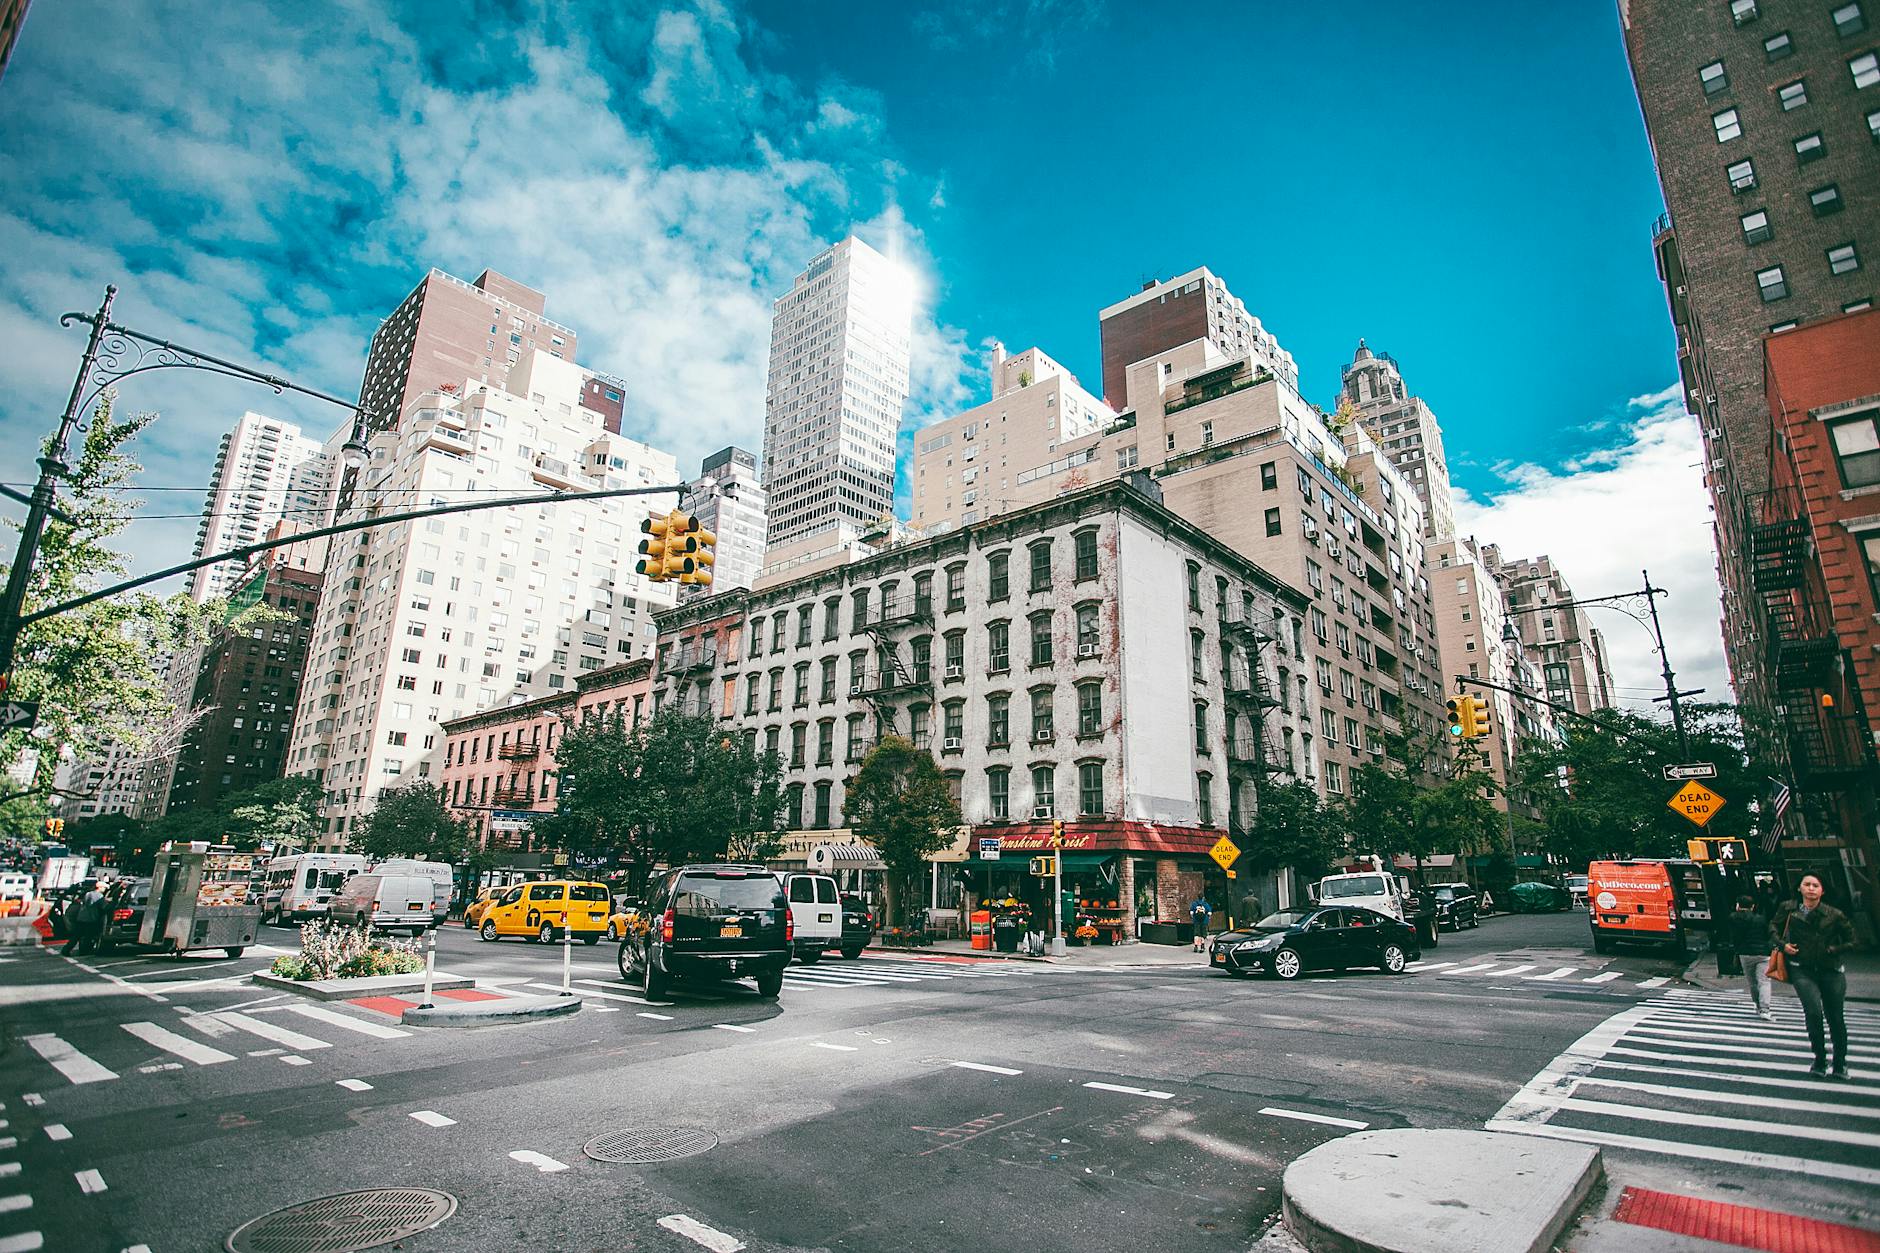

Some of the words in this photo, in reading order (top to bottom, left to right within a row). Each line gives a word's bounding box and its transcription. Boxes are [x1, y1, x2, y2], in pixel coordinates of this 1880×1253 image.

[1679, 793, 1711, 803] DEAD
[1686, 805, 1709, 814] END
[1046, 835, 1090, 849] Frist
[1597, 880, 1661, 890] AptDeco.com
